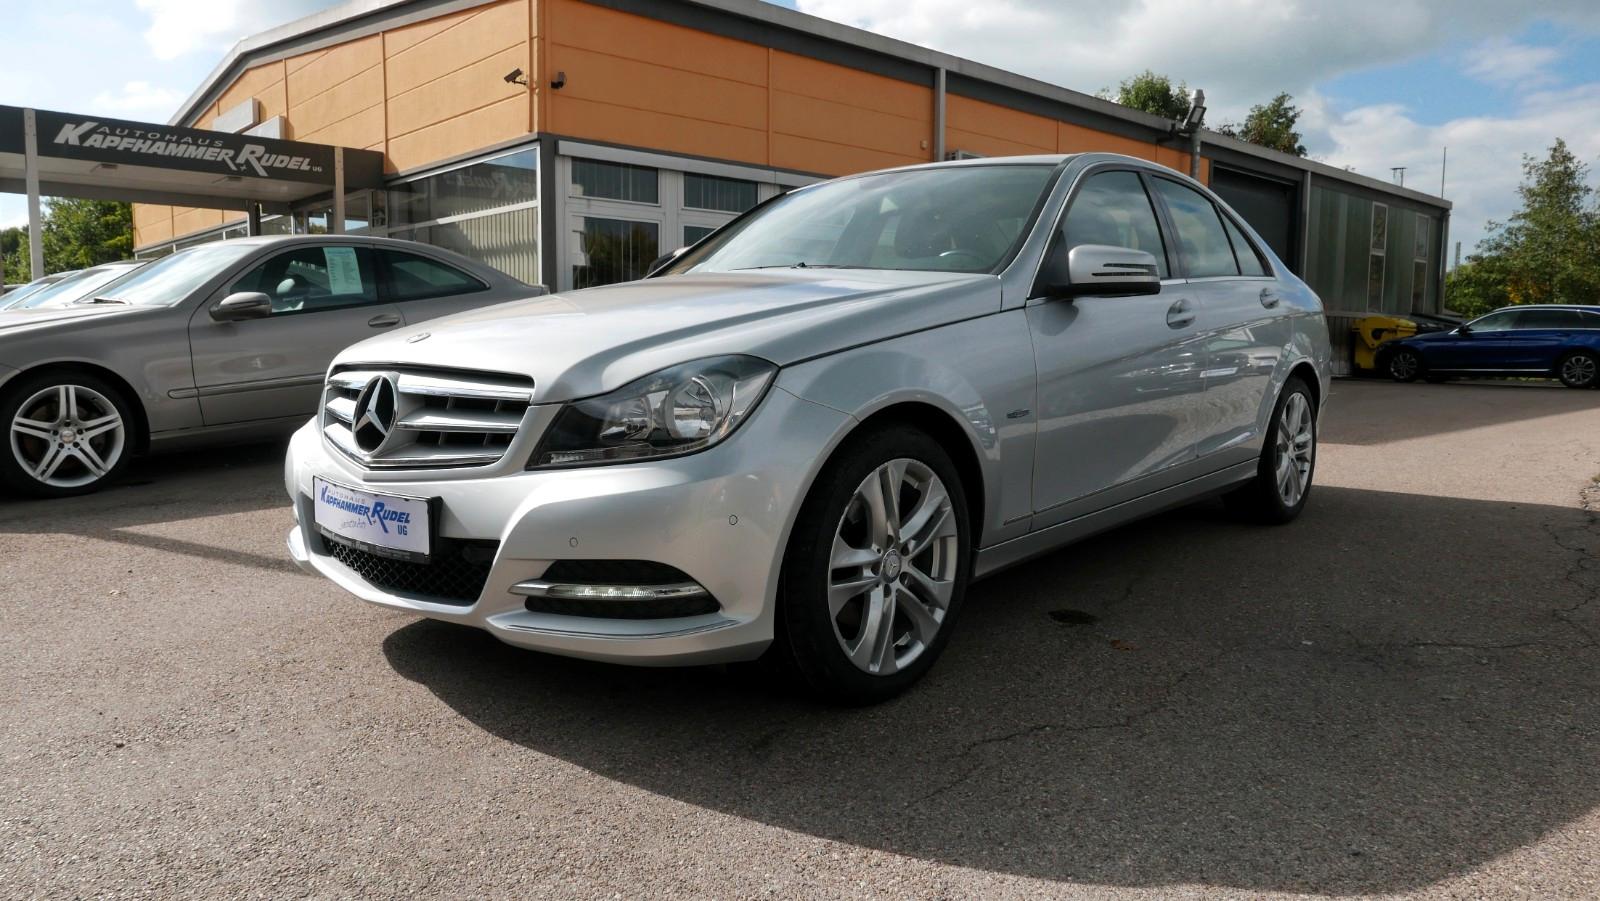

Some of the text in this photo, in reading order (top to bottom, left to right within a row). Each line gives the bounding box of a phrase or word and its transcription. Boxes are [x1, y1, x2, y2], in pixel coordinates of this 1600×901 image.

[54, 121, 238, 171] KAPFHAMMER
[235, 143, 312, 177] RUDEL
[97, 126, 224, 148] AUTOHAUS
[320, 485, 372, 525] KAPFHAMMER
[371, 501, 410, 534] RUDEL
[397, 524, 408, 536] UG
